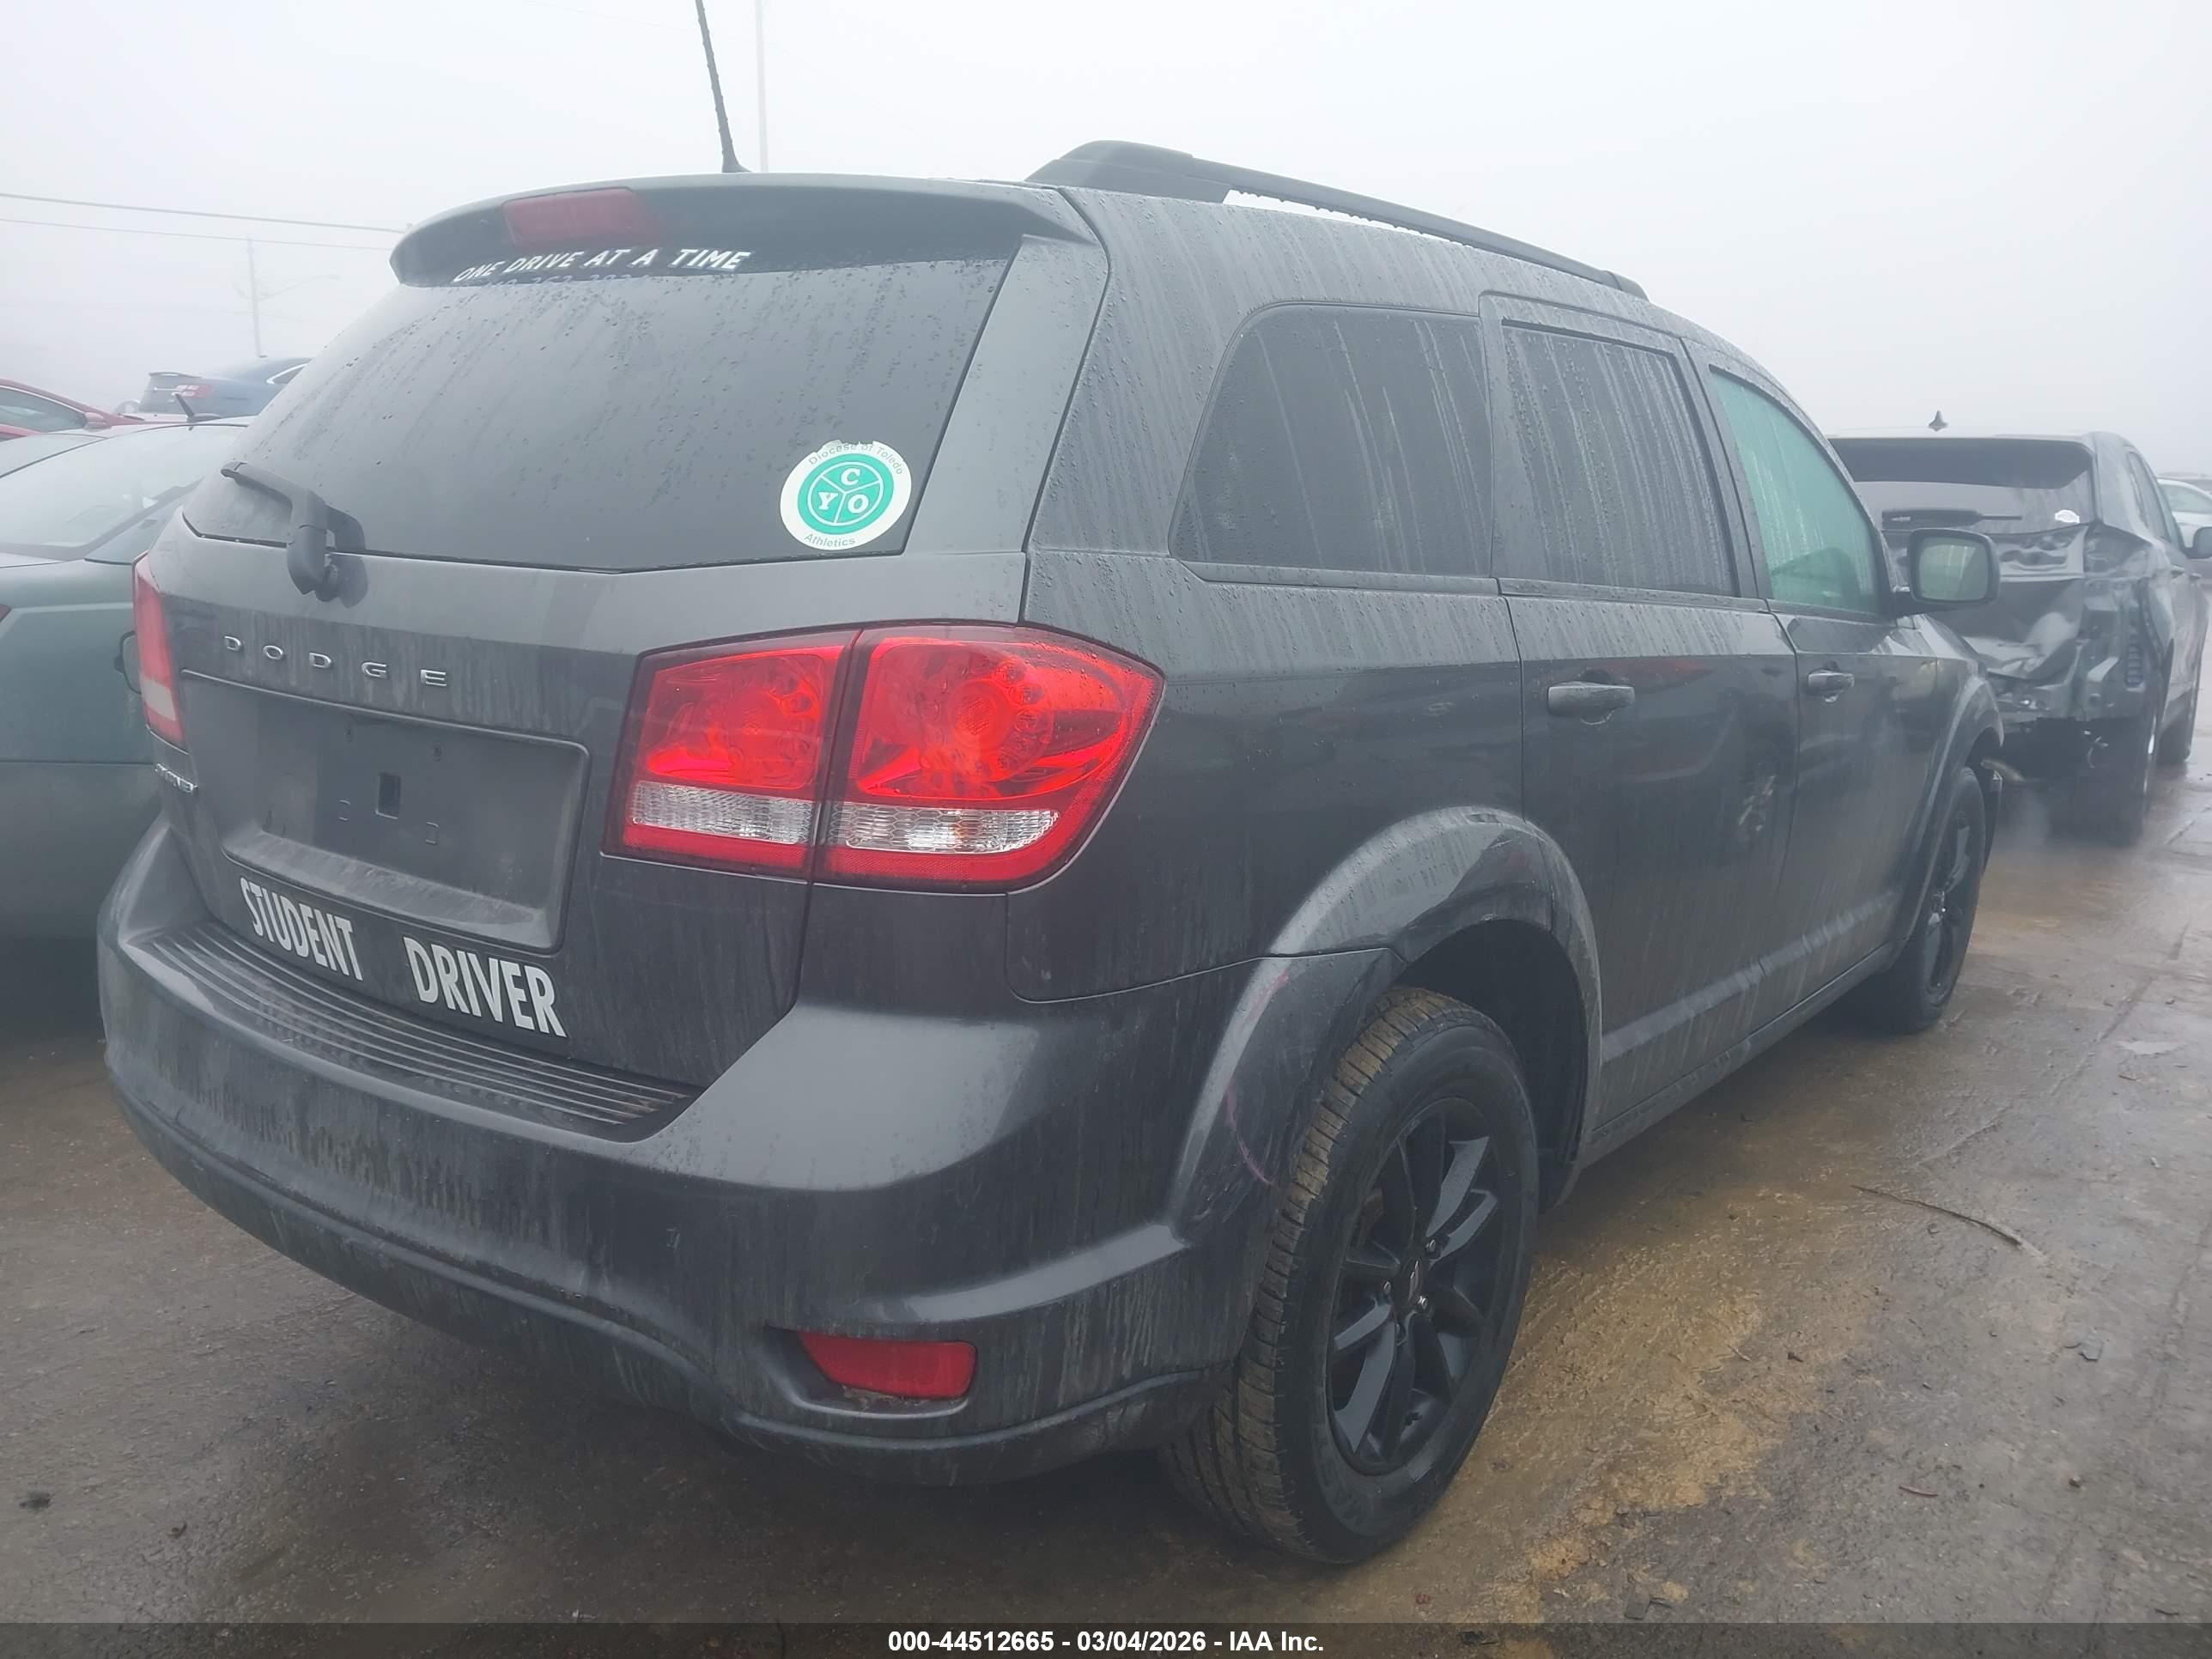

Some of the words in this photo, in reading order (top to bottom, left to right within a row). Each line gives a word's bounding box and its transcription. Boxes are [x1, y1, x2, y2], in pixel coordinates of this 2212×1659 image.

[453, 260, 507, 283] ONE
[502, 251, 585, 273] DRIVE
[583, 248, 632, 268] AT
[631, 248, 659, 267] A
[670, 248, 751, 270] TIME
[808, 443, 857, 465] Diocese
[875, 446, 903, 475] Toledo
[804, 532, 856, 548] Athletics
[223, 635, 447, 687] DODGE
[240, 877, 364, 981] STUDENT
[403, 936, 568, 1038] DRIVER
